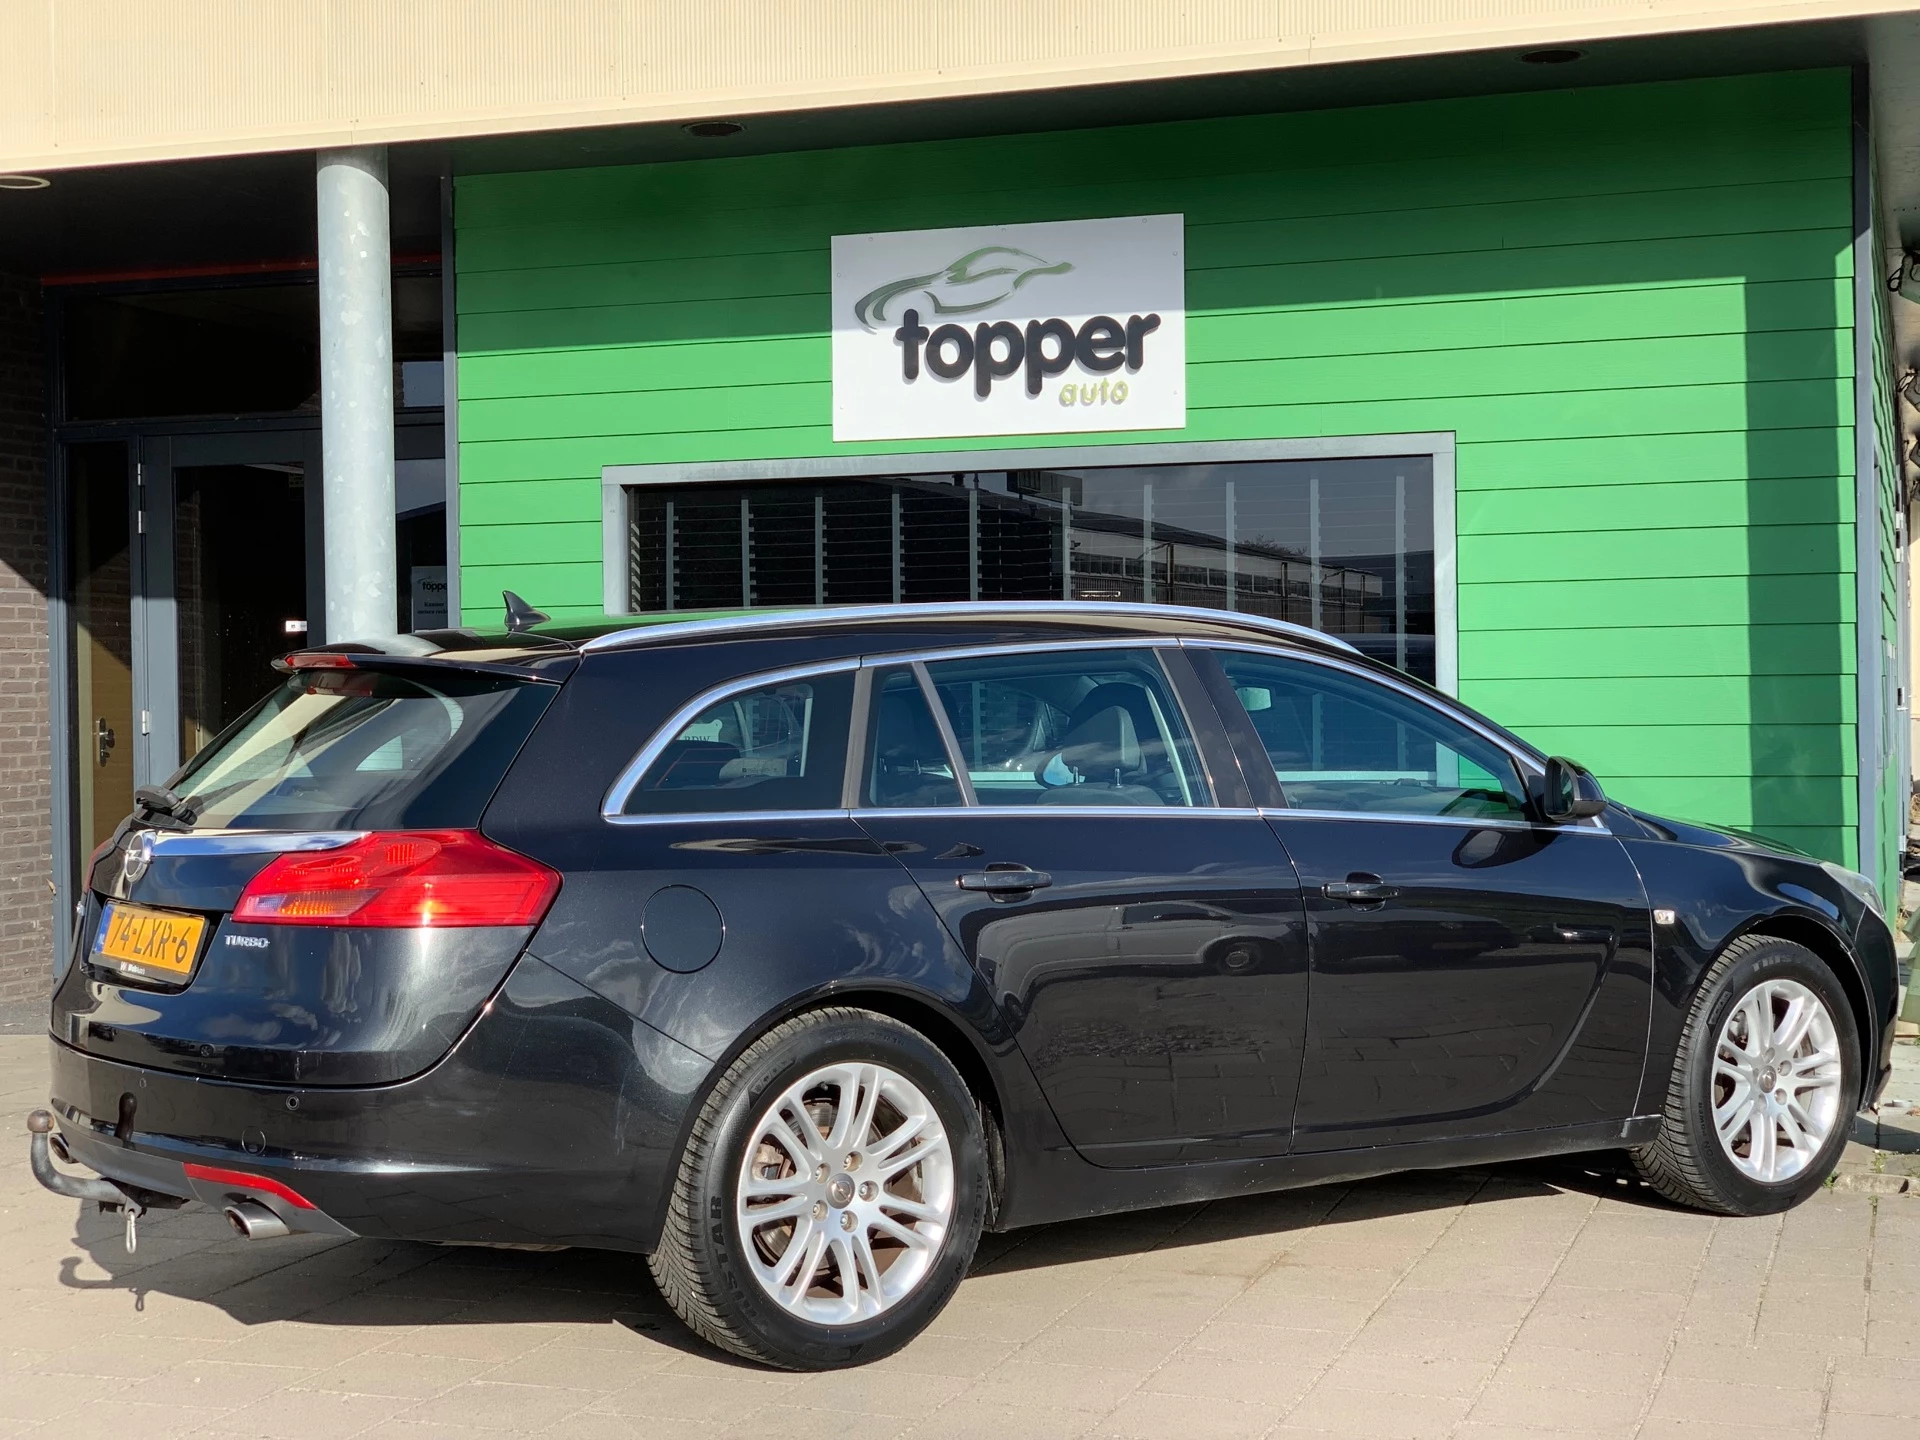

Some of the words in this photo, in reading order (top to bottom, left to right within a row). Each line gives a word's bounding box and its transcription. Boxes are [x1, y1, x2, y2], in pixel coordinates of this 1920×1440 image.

[895, 308, 1161, 397] topper
[1061, 377, 1129, 405] auto
[109, 911, 191, 964] 74-LXR-6
[224, 934, 269, 948] TURBO
